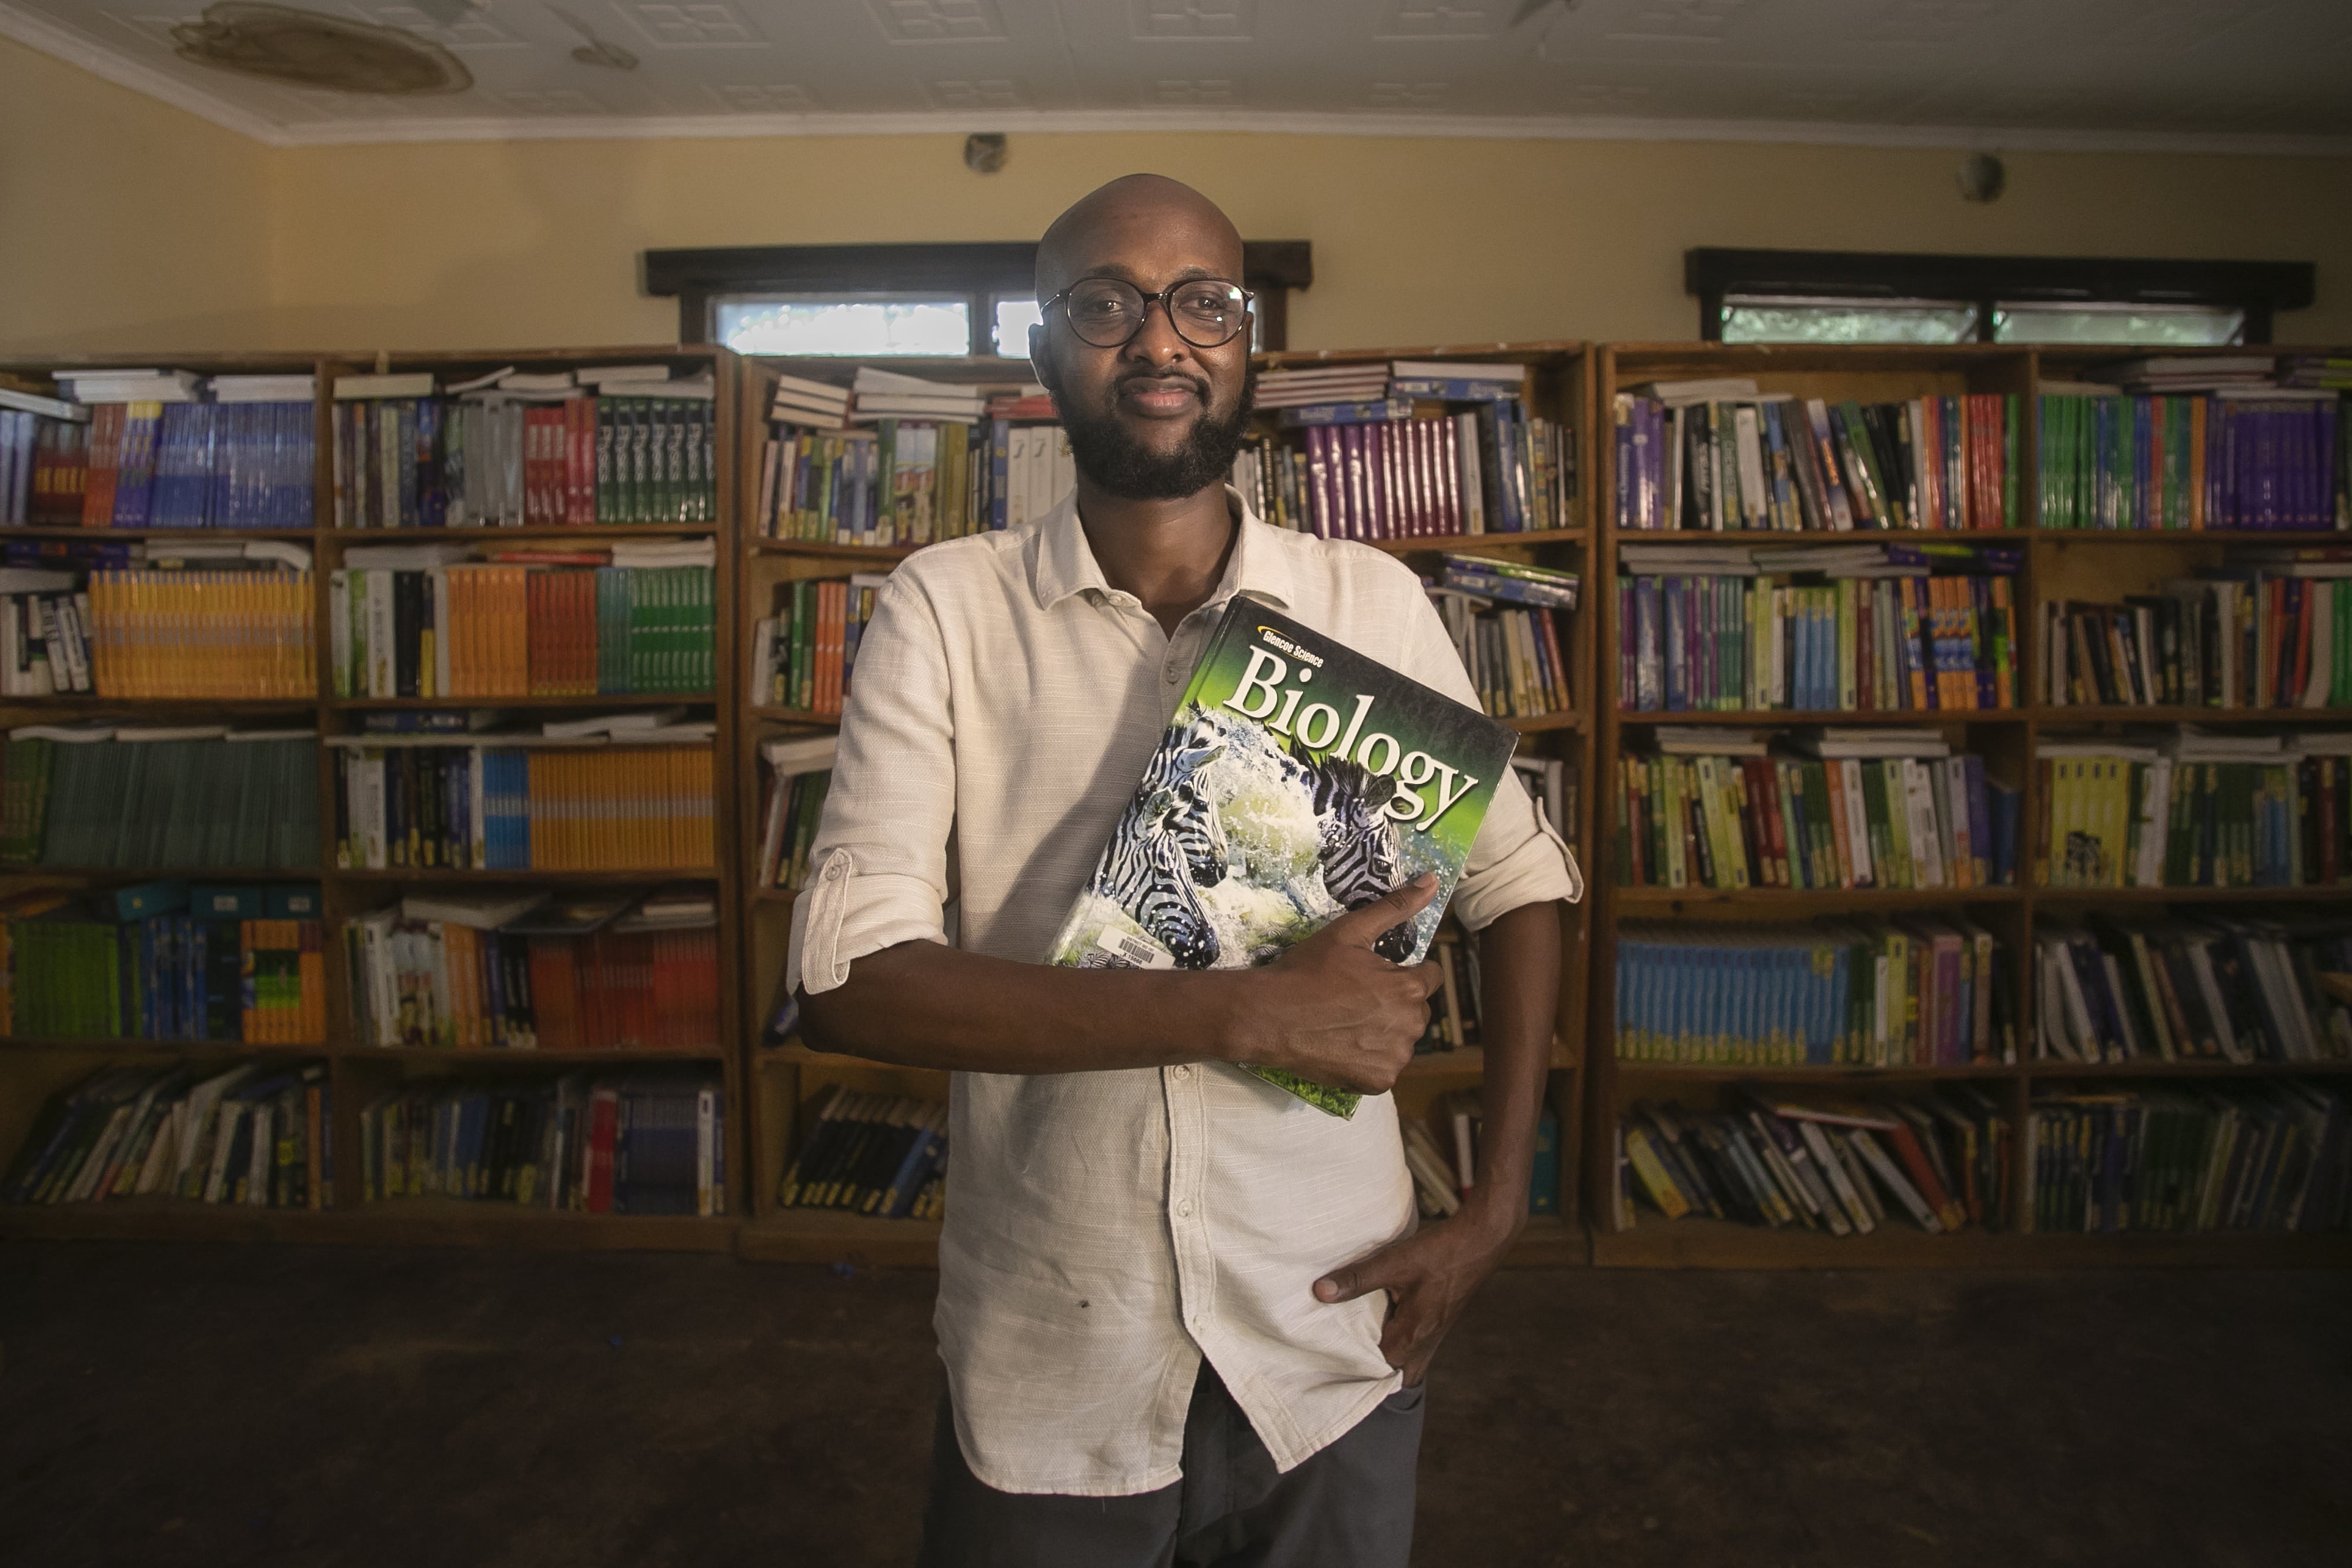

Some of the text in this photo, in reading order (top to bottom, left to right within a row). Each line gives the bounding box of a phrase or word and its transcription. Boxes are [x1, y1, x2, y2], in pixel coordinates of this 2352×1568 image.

[1262, 630, 1324, 668] Glencoe Science
[1222, 644, 1479, 831] Biology
